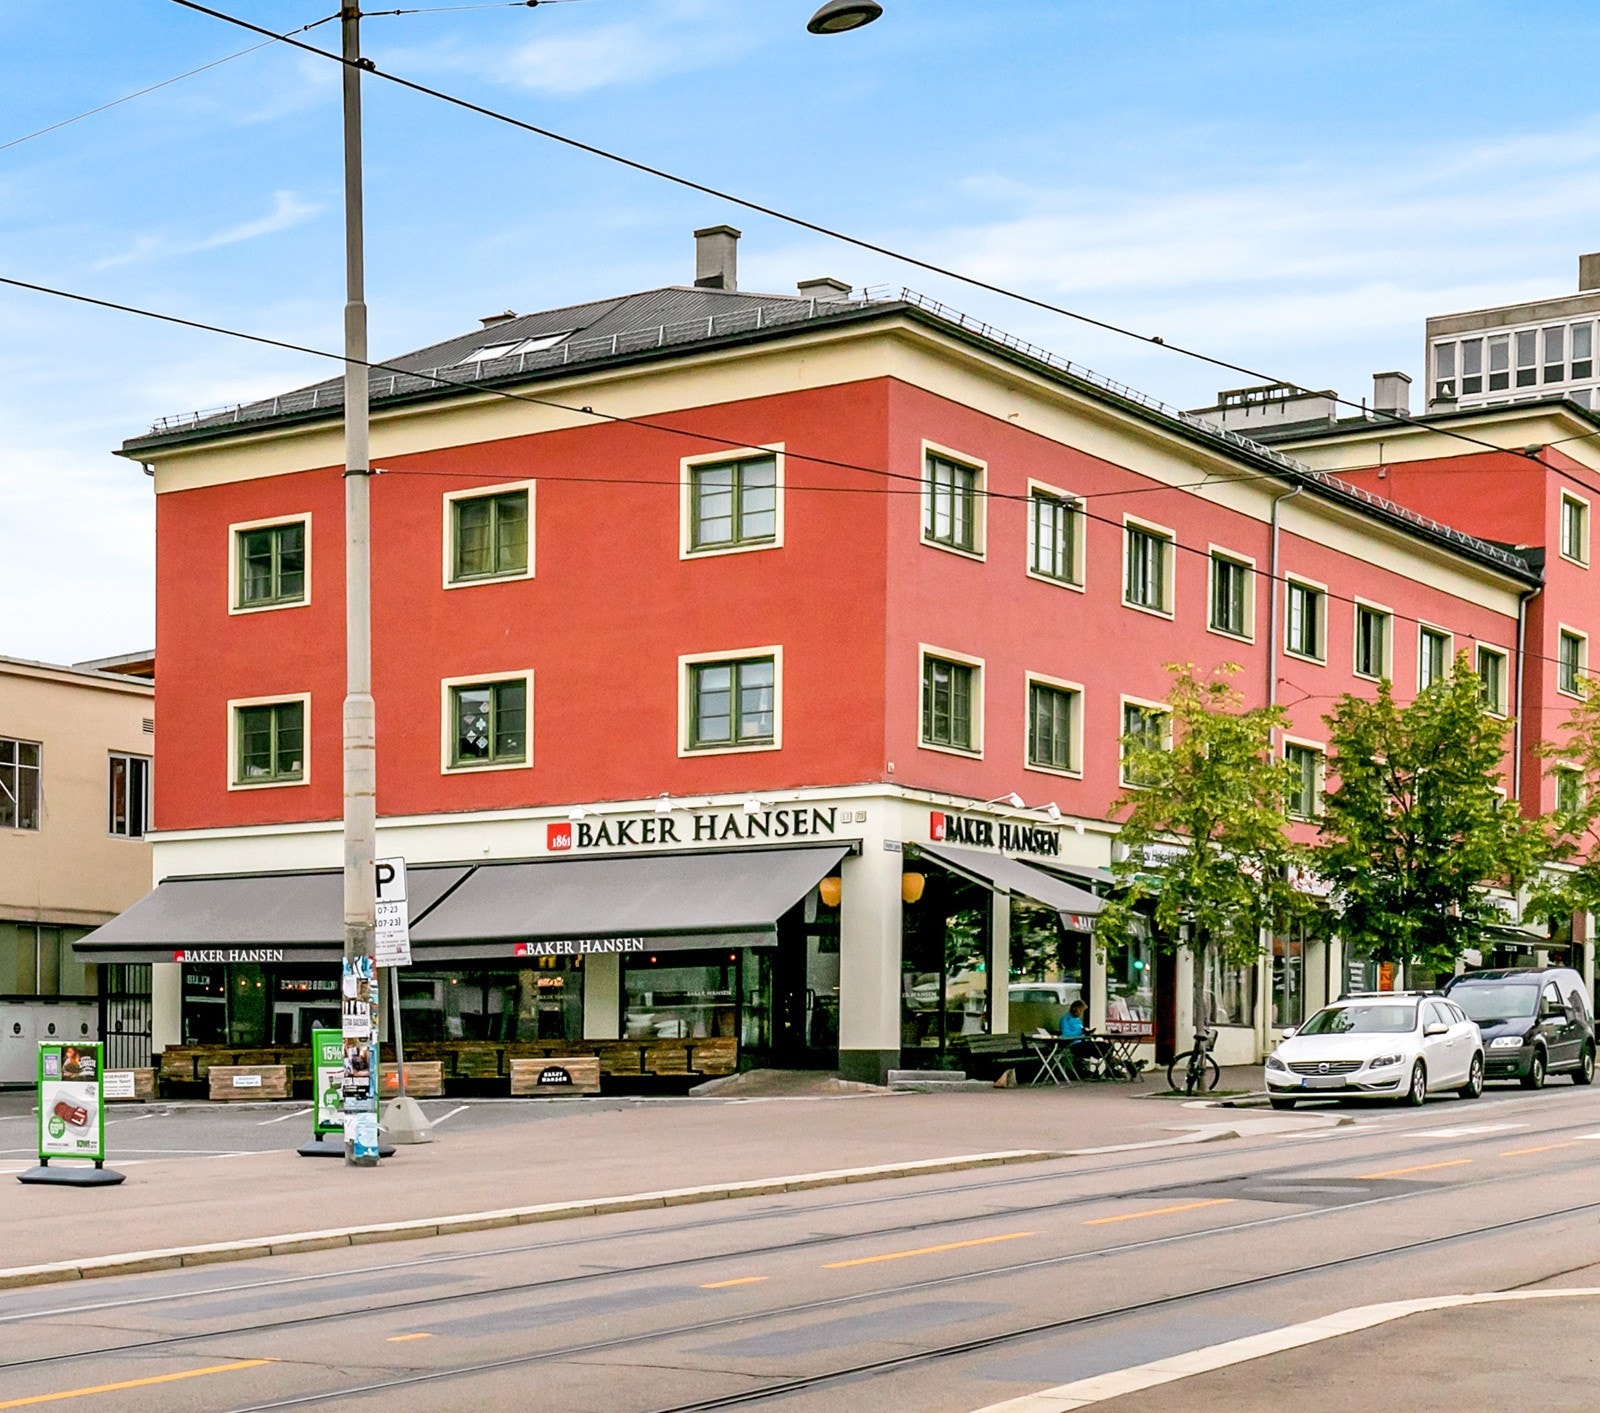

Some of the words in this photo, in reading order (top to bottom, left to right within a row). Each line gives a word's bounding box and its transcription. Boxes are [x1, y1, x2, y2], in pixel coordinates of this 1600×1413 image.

[576, 817, 681, 848] BAKER
[692, 807, 838, 841] HANSEN
[944, 814, 995, 848] BAKER
[998, 823, 1059, 856] HANSEN
[552, 835, 571, 847] 1861
[375, 863, 396, 898] P
[377, 905, 398, 915] 07-23
[526, 941, 576, 955] BAKER
[579, 937, 644, 954] HANSEN
[184, 949, 225, 962] BAKER
[229, 949, 283, 962] HANSEN
[323, 1046, 342, 1060] 15%
